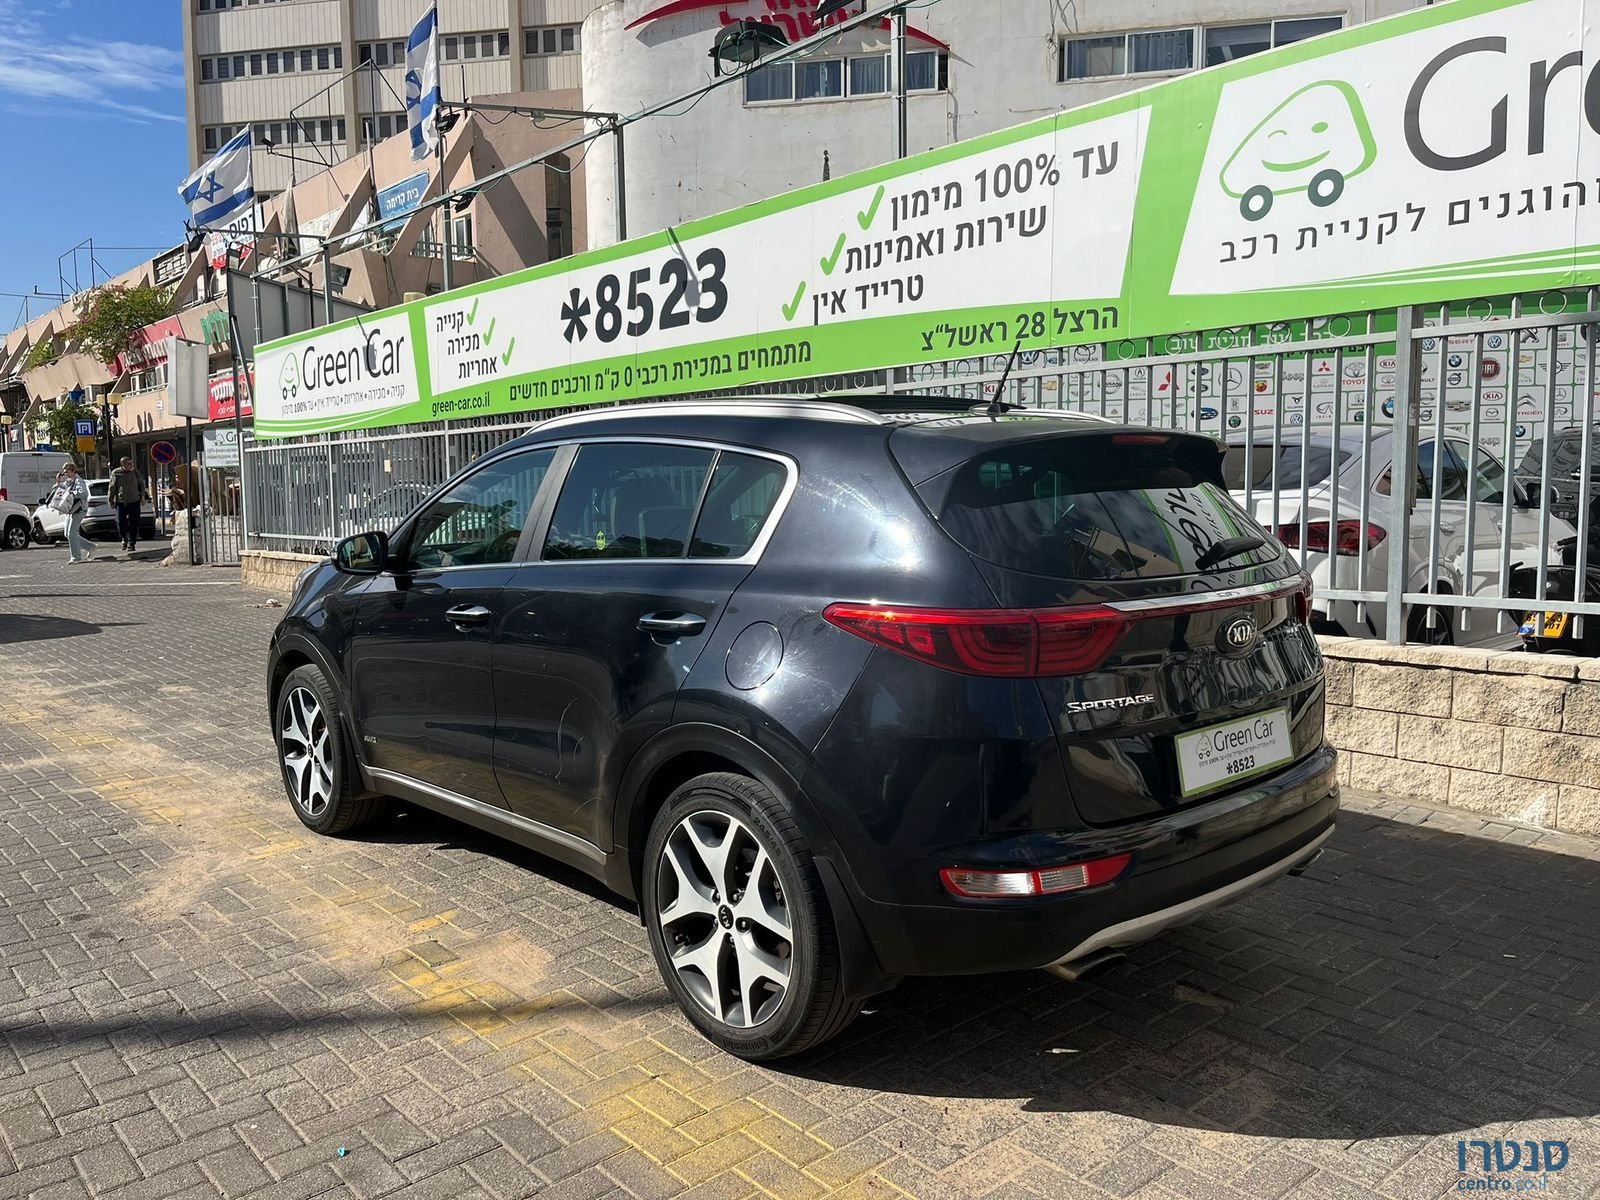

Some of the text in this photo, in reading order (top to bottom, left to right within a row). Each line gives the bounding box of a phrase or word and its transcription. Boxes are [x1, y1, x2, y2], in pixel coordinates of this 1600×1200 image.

[1403, 35, 1600, 172] Gr
[890, 141, 1119, 232] עד 100% מימון
[844, 204, 1047, 274] שירות ואמינות
[1295, 203, 1426, 252] לקניית
[1219, 233, 1278, 264] רכב
[812, 273, 924, 327] טרייד אין
[436, 309, 464, 334] קנייה
[1015, 310, 1046, 341] 28
[1053, 298, 1119, 335] הרצל
[447, 333, 480, 357] מכירה
[738, 340, 811, 371] מתמחים
[302, 328, 405, 391] Green Car
[458, 355, 497, 380] אחריות
[672, 354, 732, 381] במכירת
[551, 374, 591, 396] ורכבים
[624, 366, 633, 387] 0
[637, 364, 668, 385] רכבי
[1341, 378, 1366, 386] TOYOT
[431, 390, 490, 418] green-car.co.il
[510, 381, 548, 401] חדשים
[226, 431, 238, 443] Gr
[1233, 624, 1252, 642] KIA
[1066, 693, 1155, 715] SPORTAGE
[1213, 727, 1253, 752] Green
[1253, 719, 1274, 740] Car
